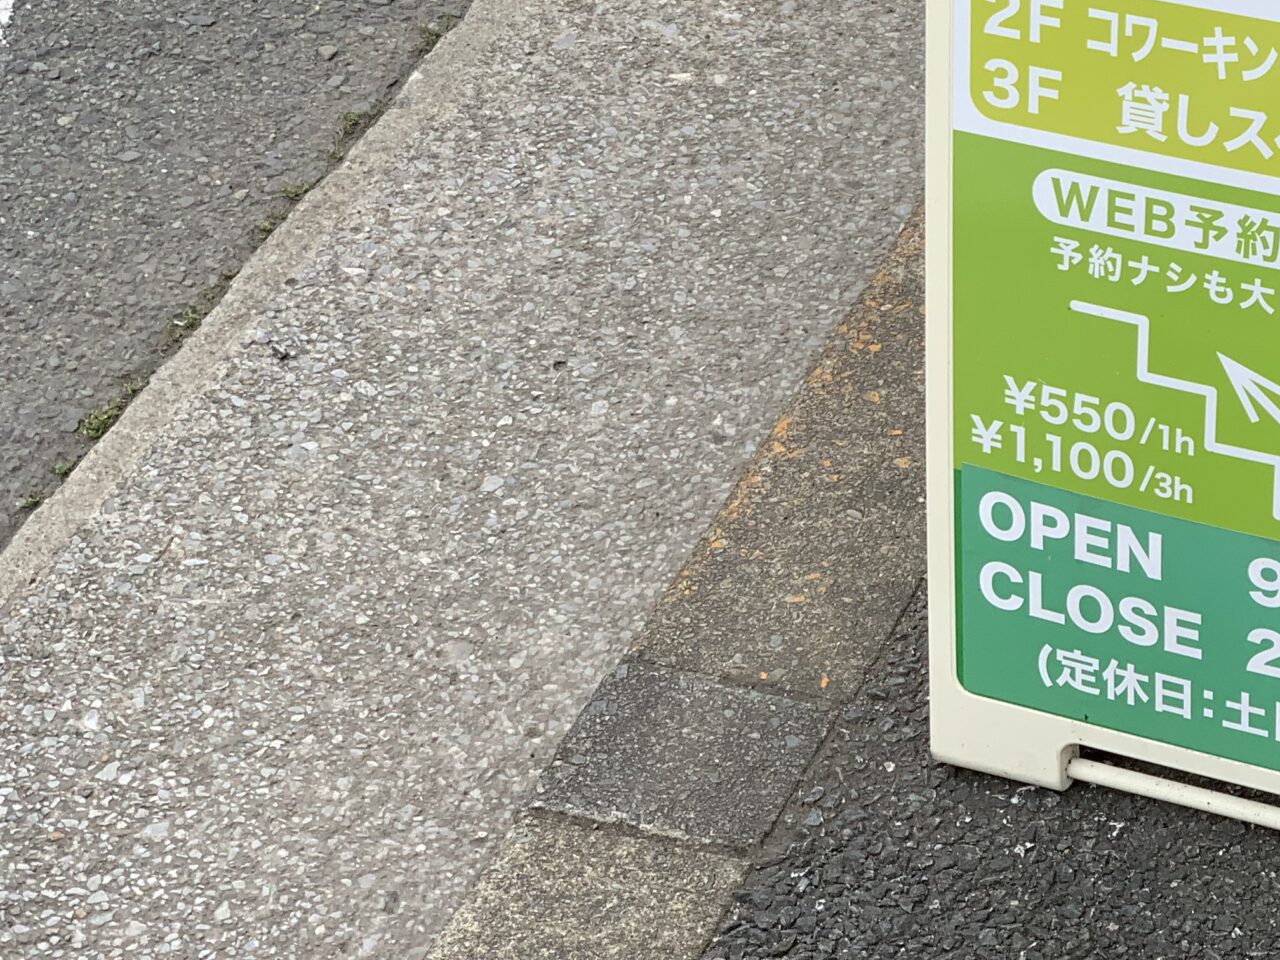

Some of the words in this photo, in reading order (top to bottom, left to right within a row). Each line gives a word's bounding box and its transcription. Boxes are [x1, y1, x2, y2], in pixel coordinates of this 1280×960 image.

[982, 58, 1063, 115] 3F
[978, 490, 1163, 581] OPEN
[978, 560, 1203, 660] CLOSE
